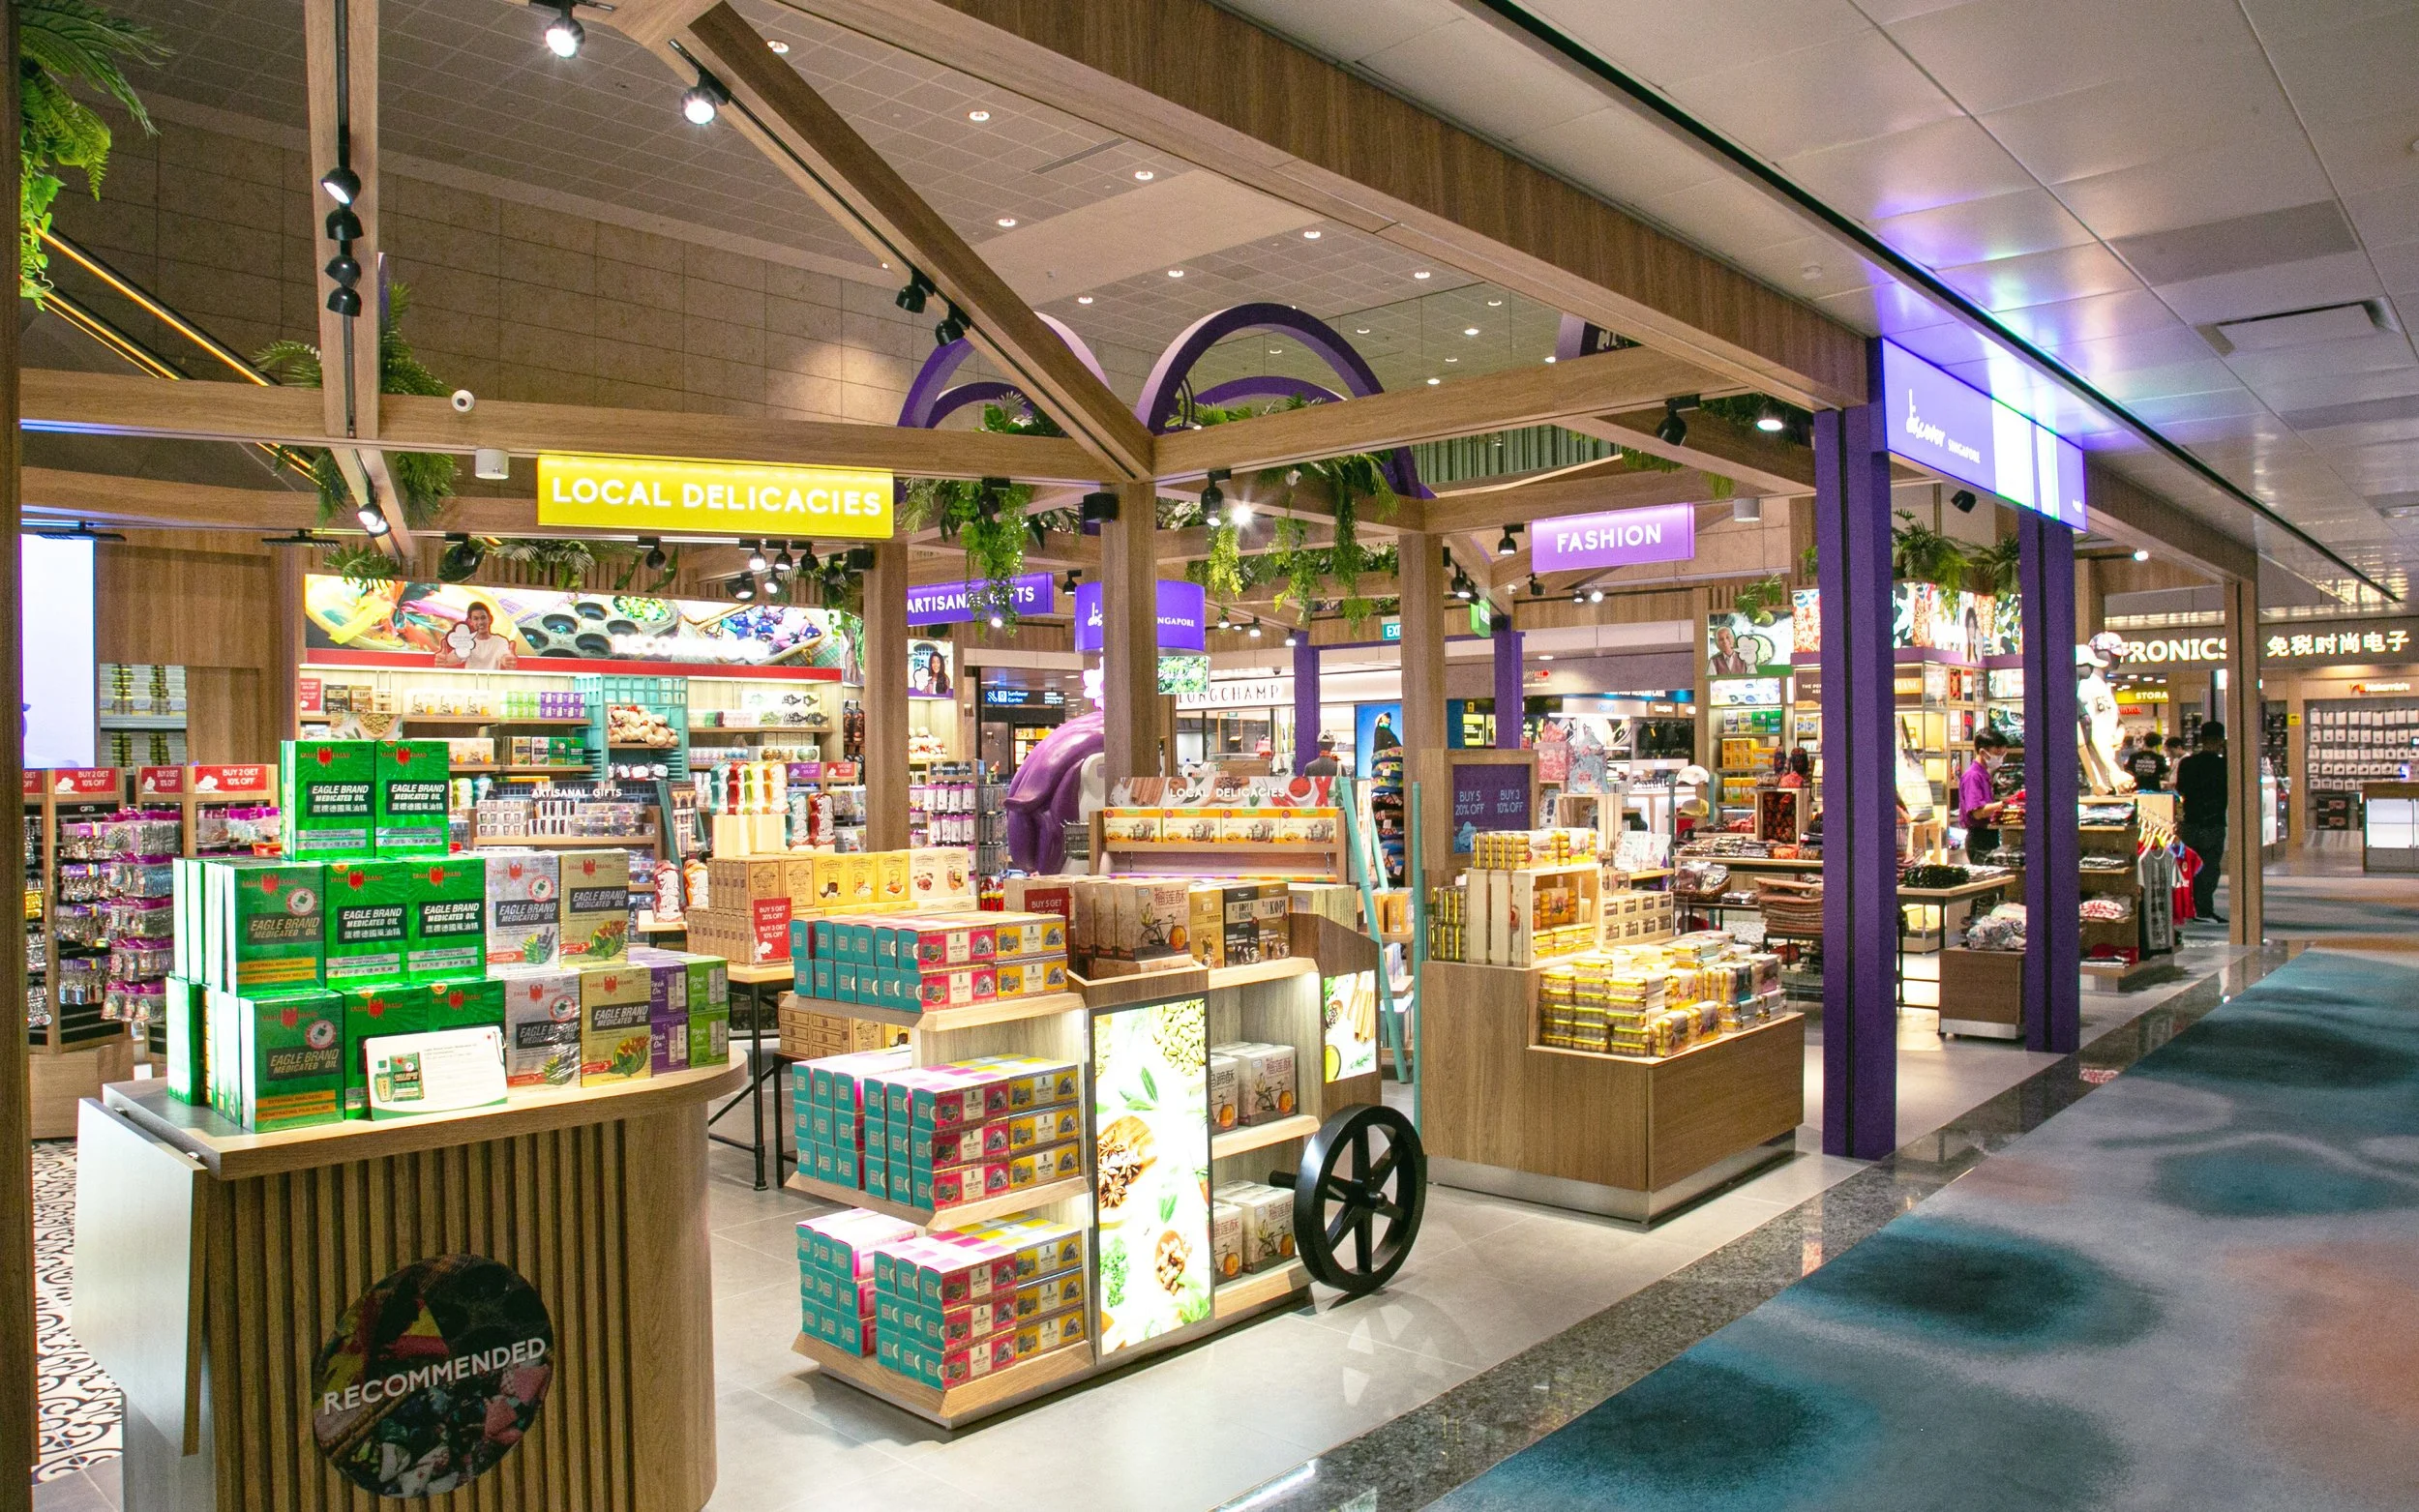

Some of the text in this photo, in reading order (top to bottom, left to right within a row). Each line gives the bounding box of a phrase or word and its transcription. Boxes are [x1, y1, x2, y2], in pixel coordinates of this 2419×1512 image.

[552, 477, 881, 517] LOCAL DELICACIES
[1557, 522, 1662, 553] FASHION
[2266, 630, 2410, 658] 免税时尚电子
[312, 785, 369, 794] EAGLE BRAND
[391, 784, 445, 793] EAGLE BRAND
[532, 788, 622, 798] ARTISANAL GIFTS
[1170, 787, 1285, 797] LOCAL DELICACIES
[1459, 790, 1481, 802] BUY 5
[1500, 789, 1520, 801] BUY 3
[1455, 803, 1485, 815] 20% OFF
[1497, 802, 1524, 814] 10% OFF
[573, 890, 626, 902] EAGLE BRAND
[424, 903, 480, 915] EAGLE BRAND
[499, 903, 556, 916] EAGLE BRAND
[1031, 901, 1044, 909] BUY
[1050, 899, 1061, 907] GET
[343, 907, 403, 921] EAGLE BRAND
[427, 913, 463, 922] MEDICATED
[501, 914, 540, 923] MEDICATED
[251, 917, 320, 932] EAGLE BRAND
[346, 919, 384, 928] MEDICATED
[254, 928, 317, 938] MEDICATED OIL
[594, 1005, 648, 1021] EAGLE BRAND
[596, 1018, 633, 1027] MEDICATED
[520, 1024, 548, 1037] EAGLE
[270, 1049, 340, 1067] EAGLE BRAND
[273, 1060, 337, 1074] MEDICATED OIL
[323, 1337, 547, 1415] RECOMMENDED
